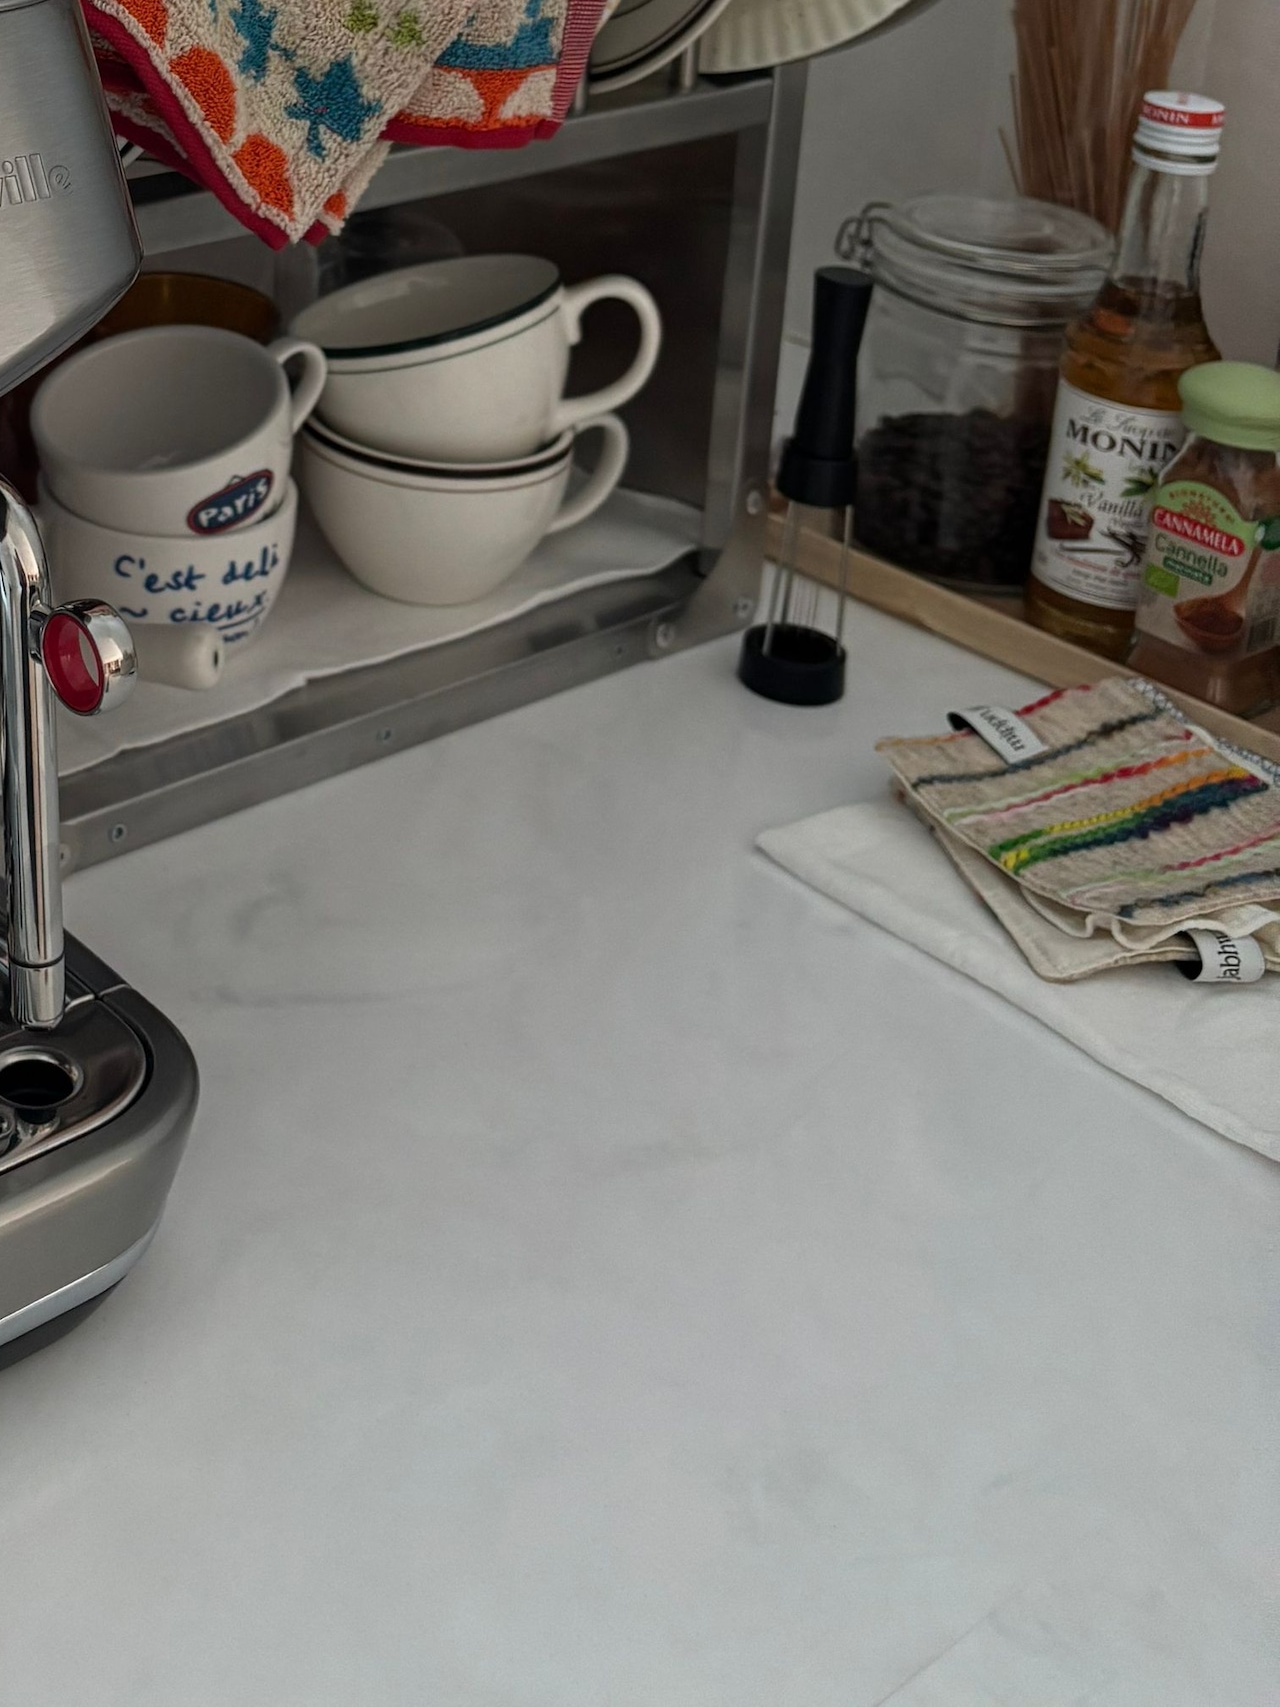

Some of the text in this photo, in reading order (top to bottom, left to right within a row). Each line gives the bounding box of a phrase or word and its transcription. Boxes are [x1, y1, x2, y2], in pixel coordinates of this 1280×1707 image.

[198, 476, 269, 528] Paris
[1154, 510, 1240, 555] CANNAMELA
[113, 554, 206, 594] C'est
[1154, 533, 1229, 578] Cannella
